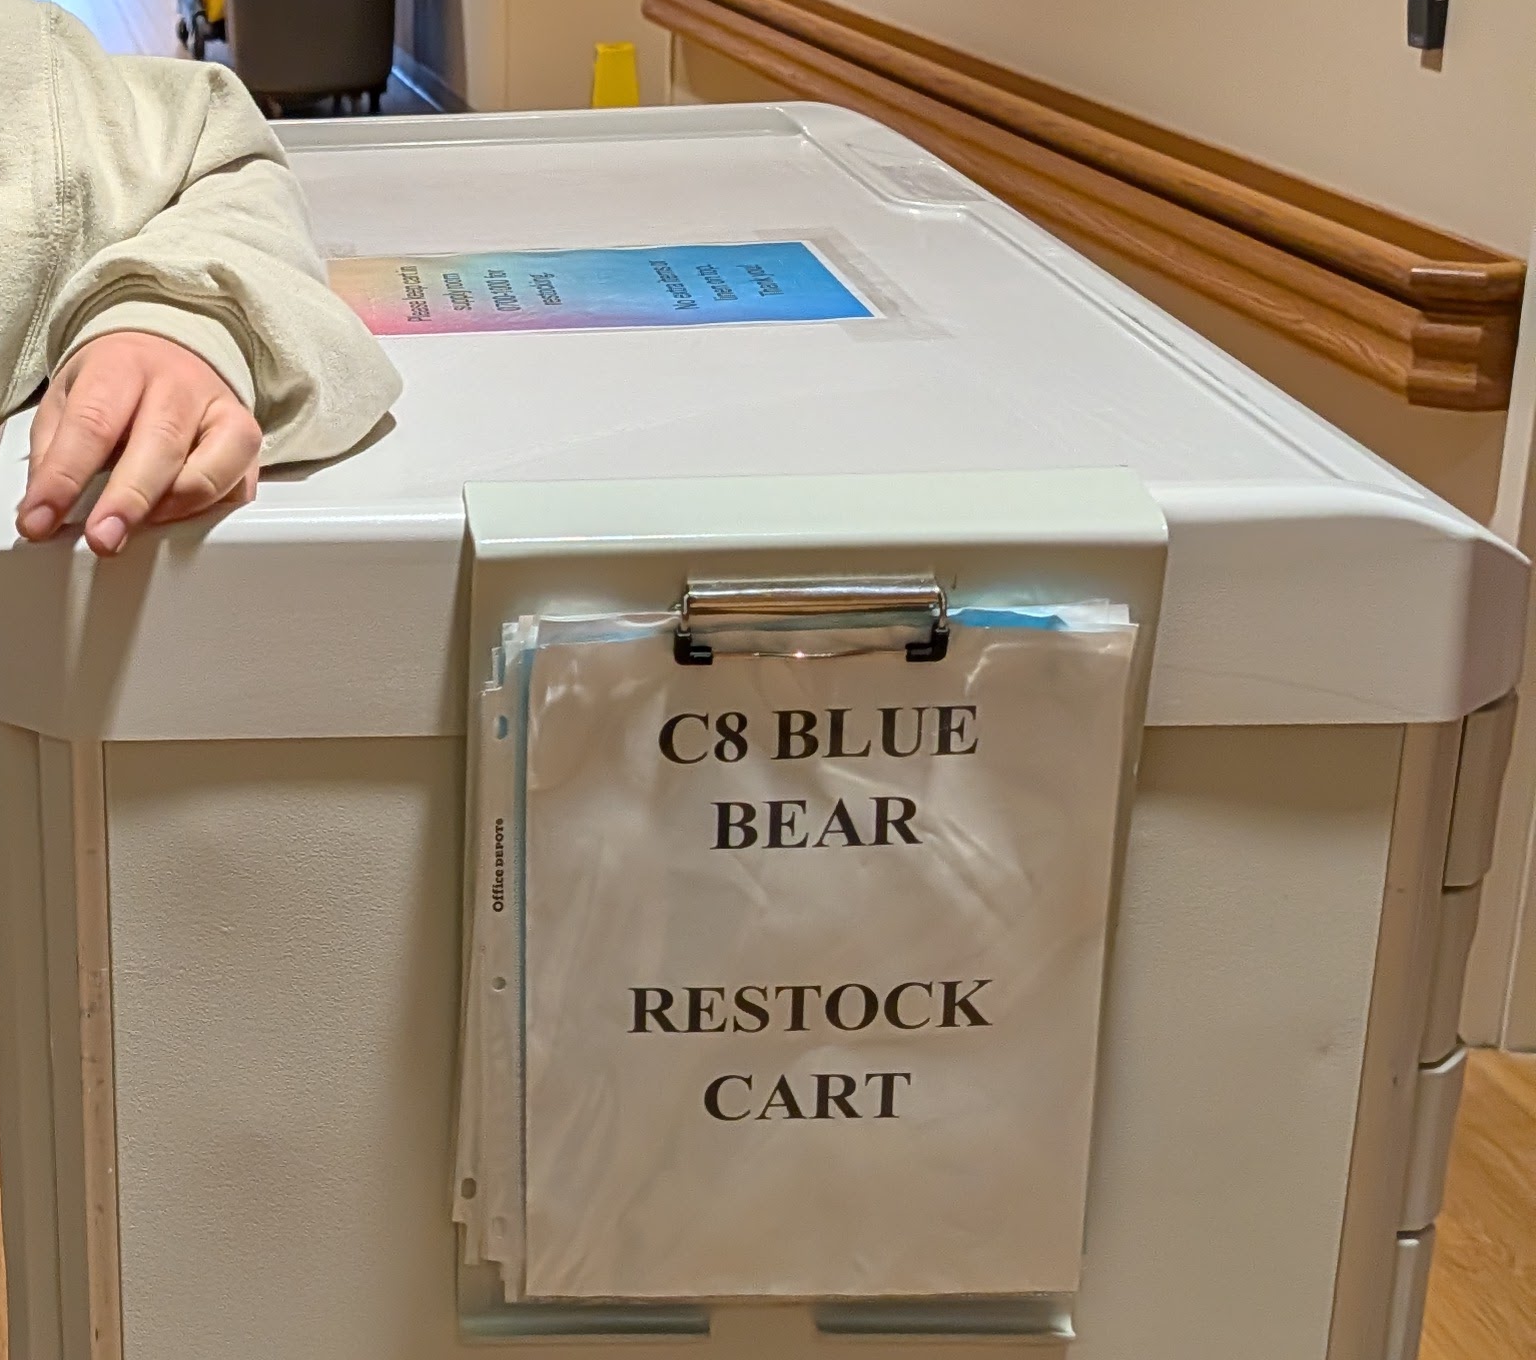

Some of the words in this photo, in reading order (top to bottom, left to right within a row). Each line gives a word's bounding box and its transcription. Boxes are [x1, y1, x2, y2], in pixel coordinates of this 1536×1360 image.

[673, 300, 700, 311] No
[657, 711, 749, 765] C8
[770, 704, 980, 762] BLUE
[709, 795, 923, 851] BEAR
[492, 869, 505, 913] Office
[626, 978, 994, 1035] RESTOCK
[703, 1071, 913, 1122] CART
